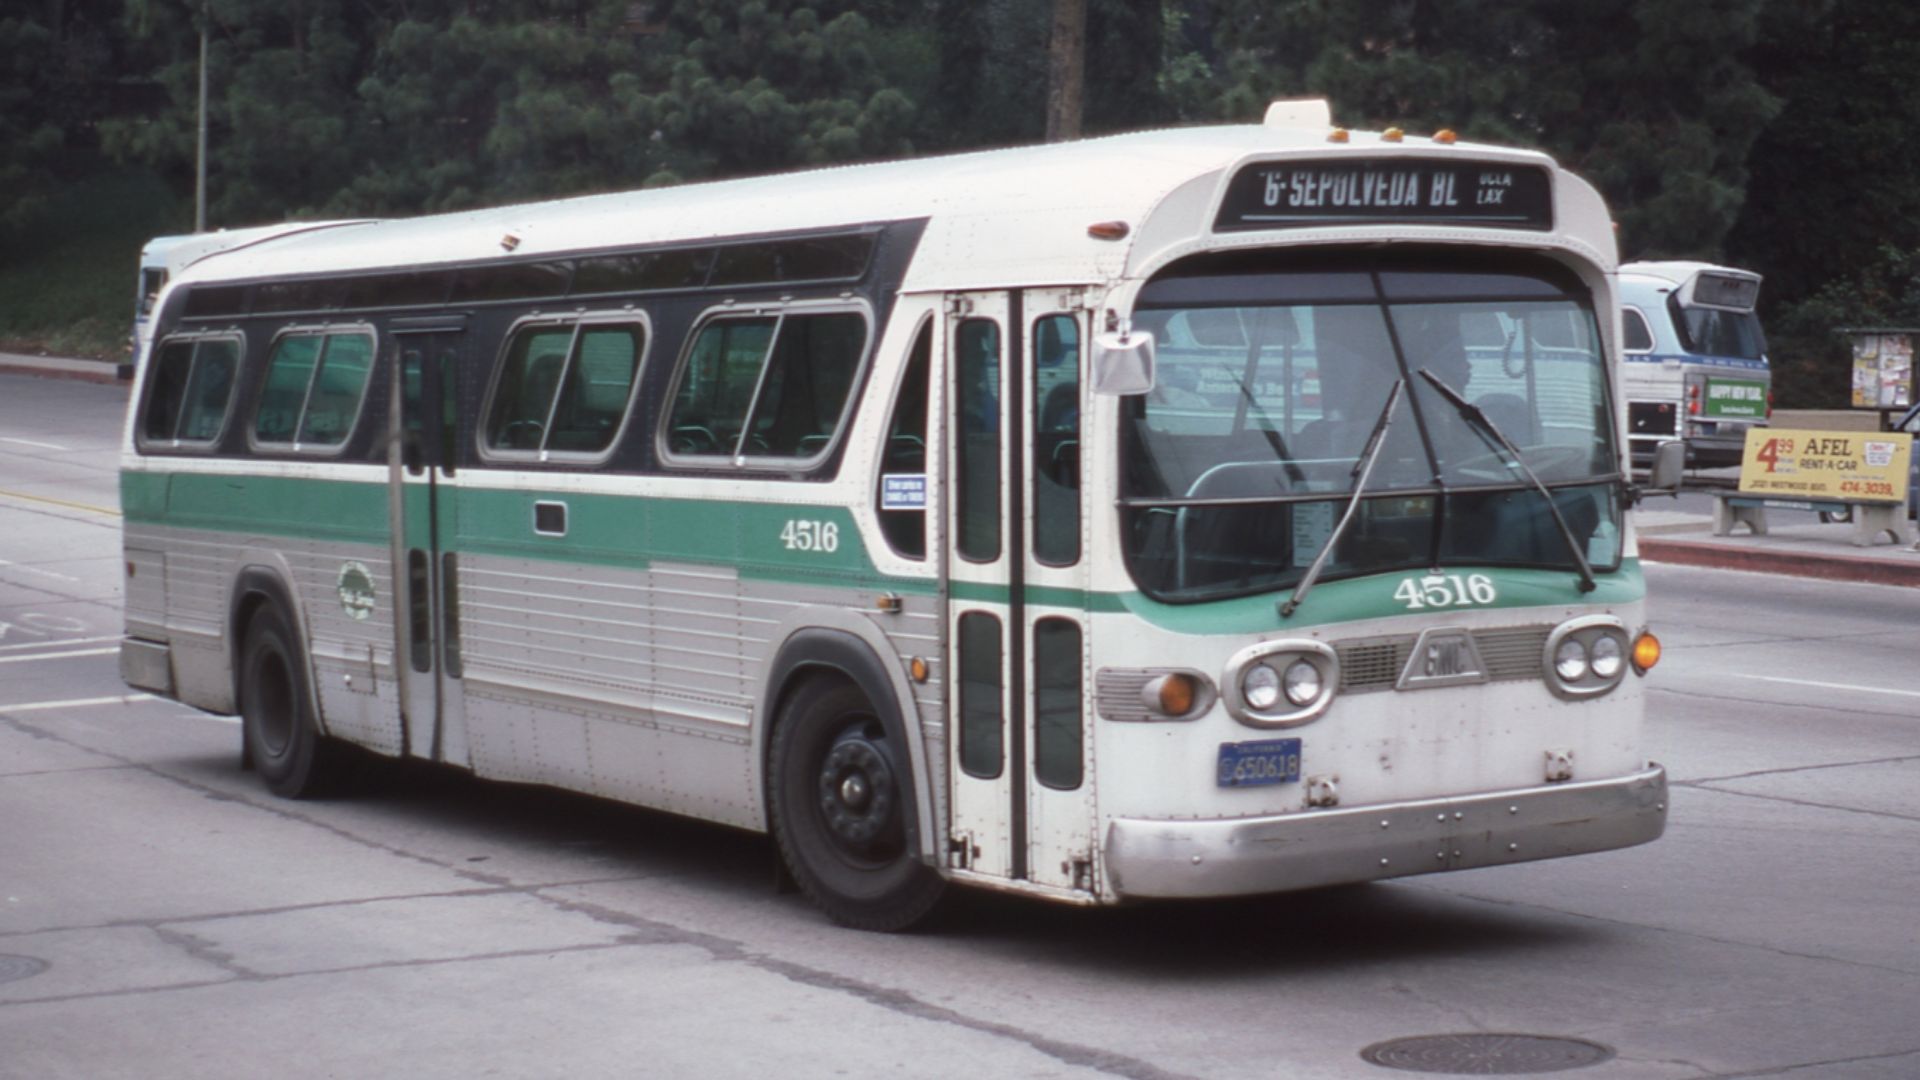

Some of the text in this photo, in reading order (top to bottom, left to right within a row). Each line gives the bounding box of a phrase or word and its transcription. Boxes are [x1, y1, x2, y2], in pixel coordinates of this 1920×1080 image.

[1429, 172, 1459, 206] BL
[1477, 189, 1504, 204] LAX
[1804, 438, 1852, 456] AFEL
[780, 520, 839, 552] 4516
[1394, 573, 1496, 608] 4516
[1234, 753, 1298, 780] 650618
